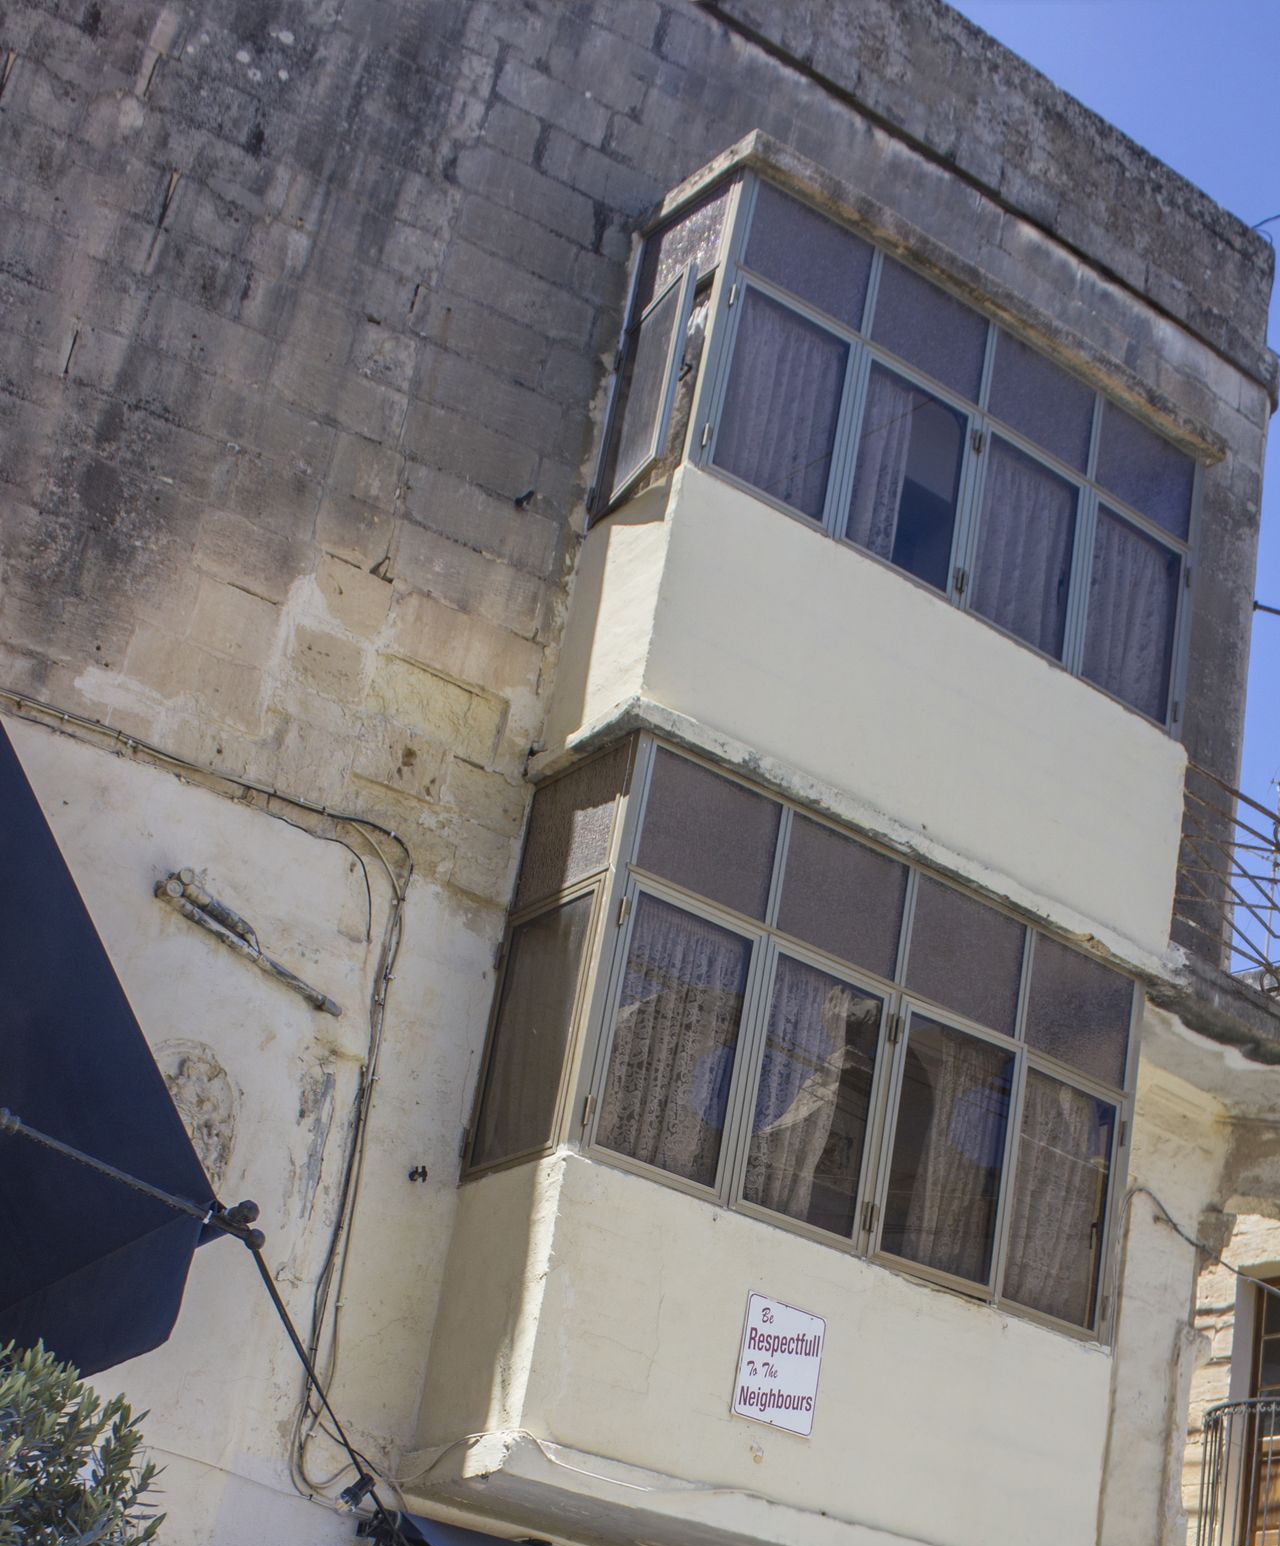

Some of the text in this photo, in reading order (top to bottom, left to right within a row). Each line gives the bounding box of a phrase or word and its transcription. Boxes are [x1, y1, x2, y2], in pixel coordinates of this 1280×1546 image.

[761, 1307, 775, 1324] Be
[748, 1326, 821, 1358] Respectfull
[747, 1360, 779, 1379] To The
[738, 1385, 813, 1413] Neighbours
